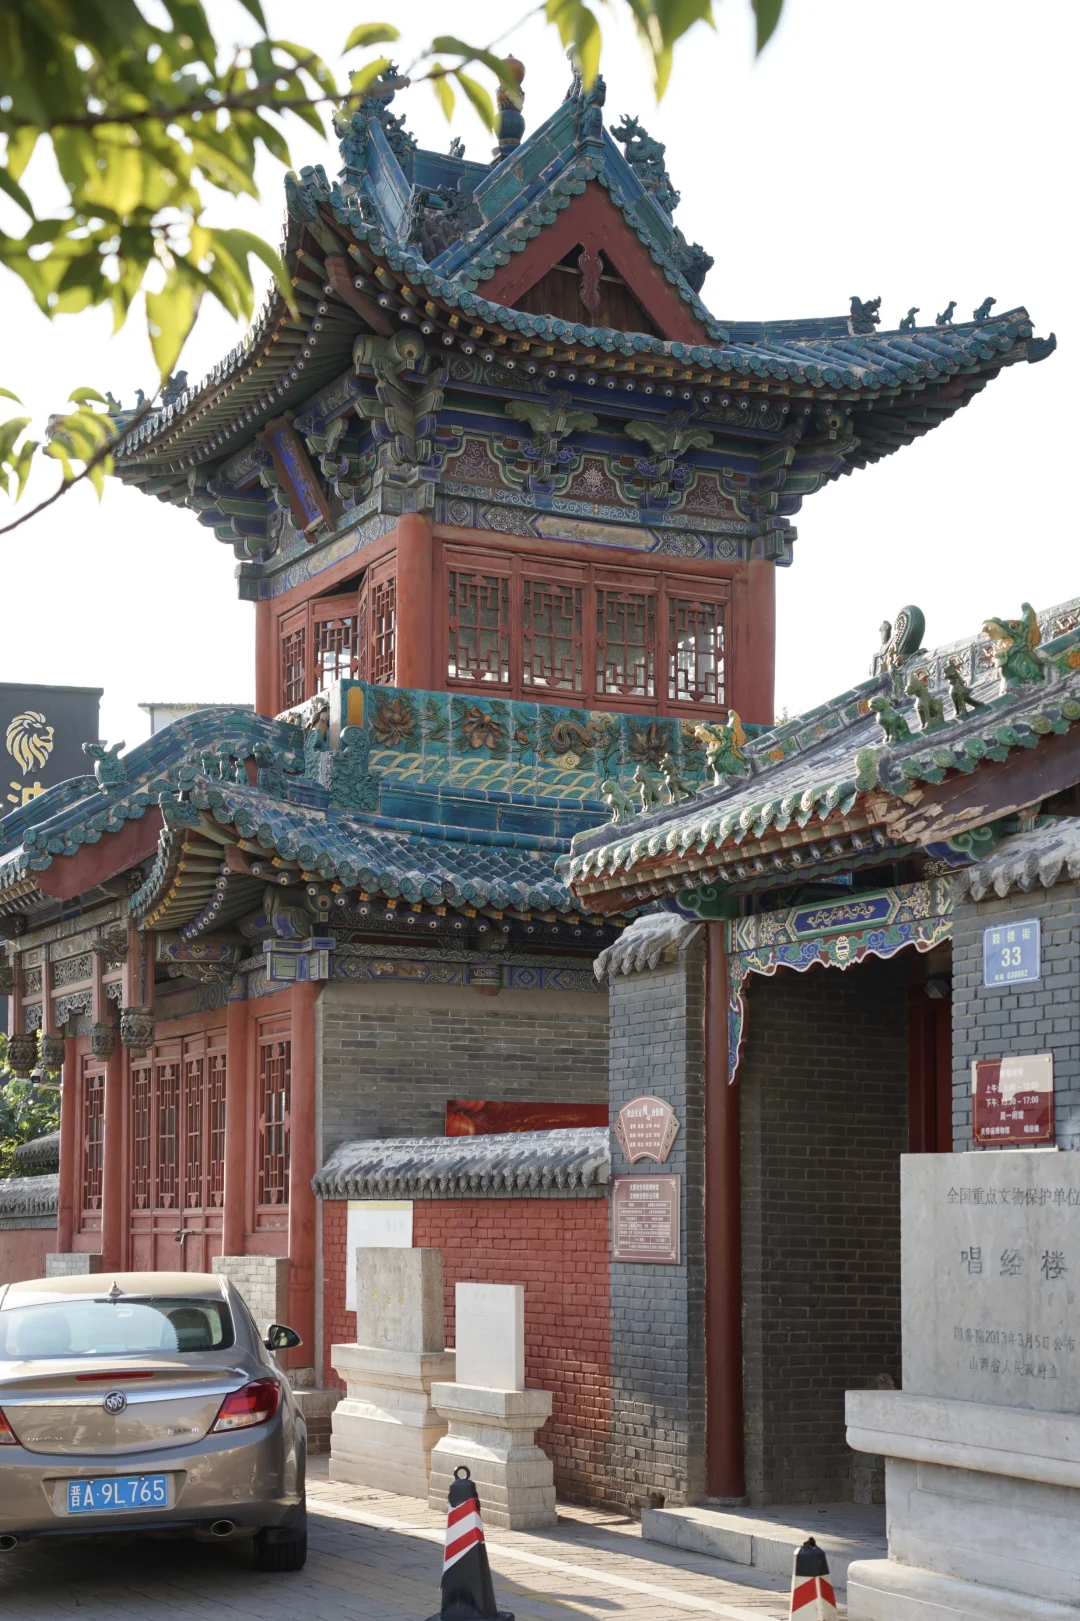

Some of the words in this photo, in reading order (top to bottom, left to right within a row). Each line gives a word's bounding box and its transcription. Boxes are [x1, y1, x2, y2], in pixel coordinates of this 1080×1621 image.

[992, 928, 1030, 944] 鼓楼街
[1001, 946, 1021, 967] 33
[1023, 1096, 1039, 1104] 17:00
[947, 1186, 1080, 1207] 全国重点文物保护单位
[960, 1246, 1069, 1280] 唱经楼
[969, 1356, 1060, 1380] 山西省人民政府立
[70, 1479, 165, 1507] 晋A·9L765
